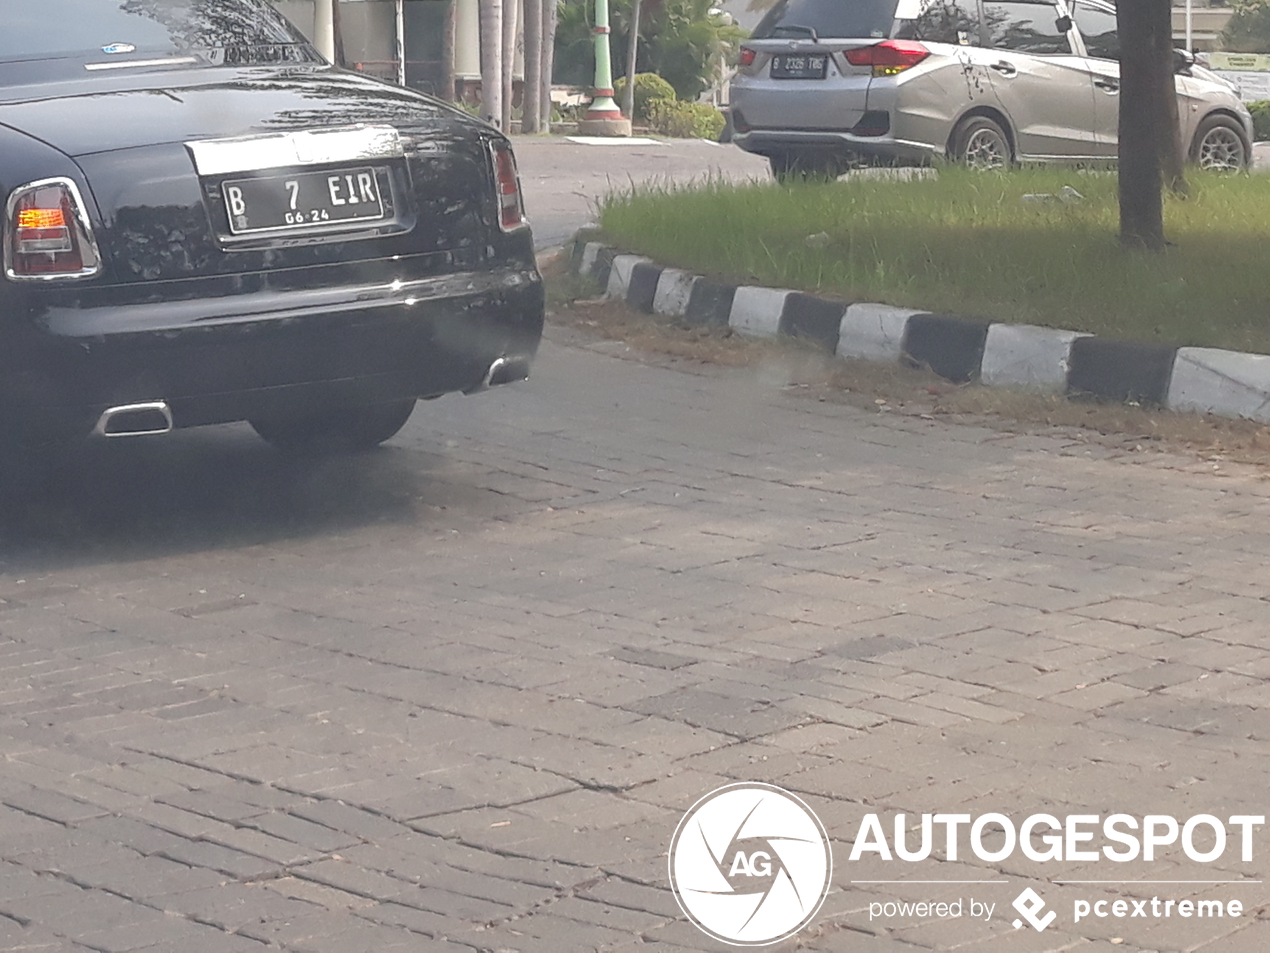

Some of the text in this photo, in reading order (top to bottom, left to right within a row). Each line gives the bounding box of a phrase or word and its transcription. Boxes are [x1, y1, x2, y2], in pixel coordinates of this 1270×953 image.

[228, 173, 376, 216] B 7 EIR
